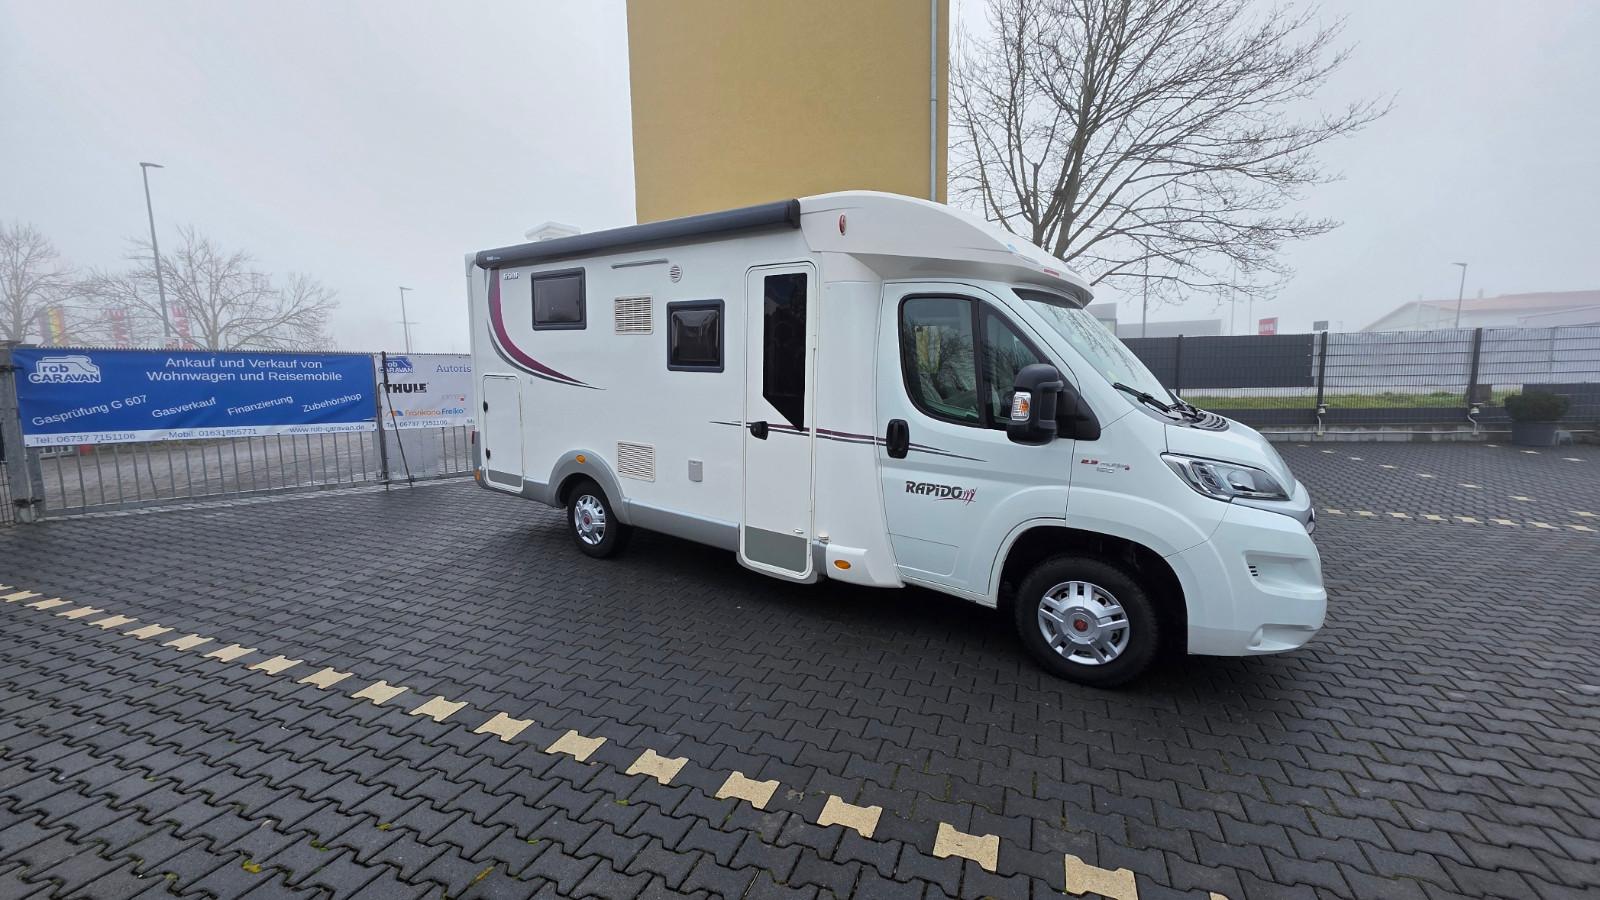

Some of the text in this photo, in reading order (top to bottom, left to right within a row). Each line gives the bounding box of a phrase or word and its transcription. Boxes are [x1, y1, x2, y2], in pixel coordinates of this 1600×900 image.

[42, 363, 69, 374] rob
[165, 357, 323, 370] Ankauf und Verkauf von
[29, 373, 101, 383] CARAVAN
[146, 370, 343, 383] Wohnwagen und Reisemobile
[386, 383, 427, 394] THULE
[32, 394, 148, 426] Gasprüfung G 607
[152, 396, 216, 418] Gasverkauf
[227, 396, 293, 416] Finanzierung
[56, 434, 89, 443] 06737
